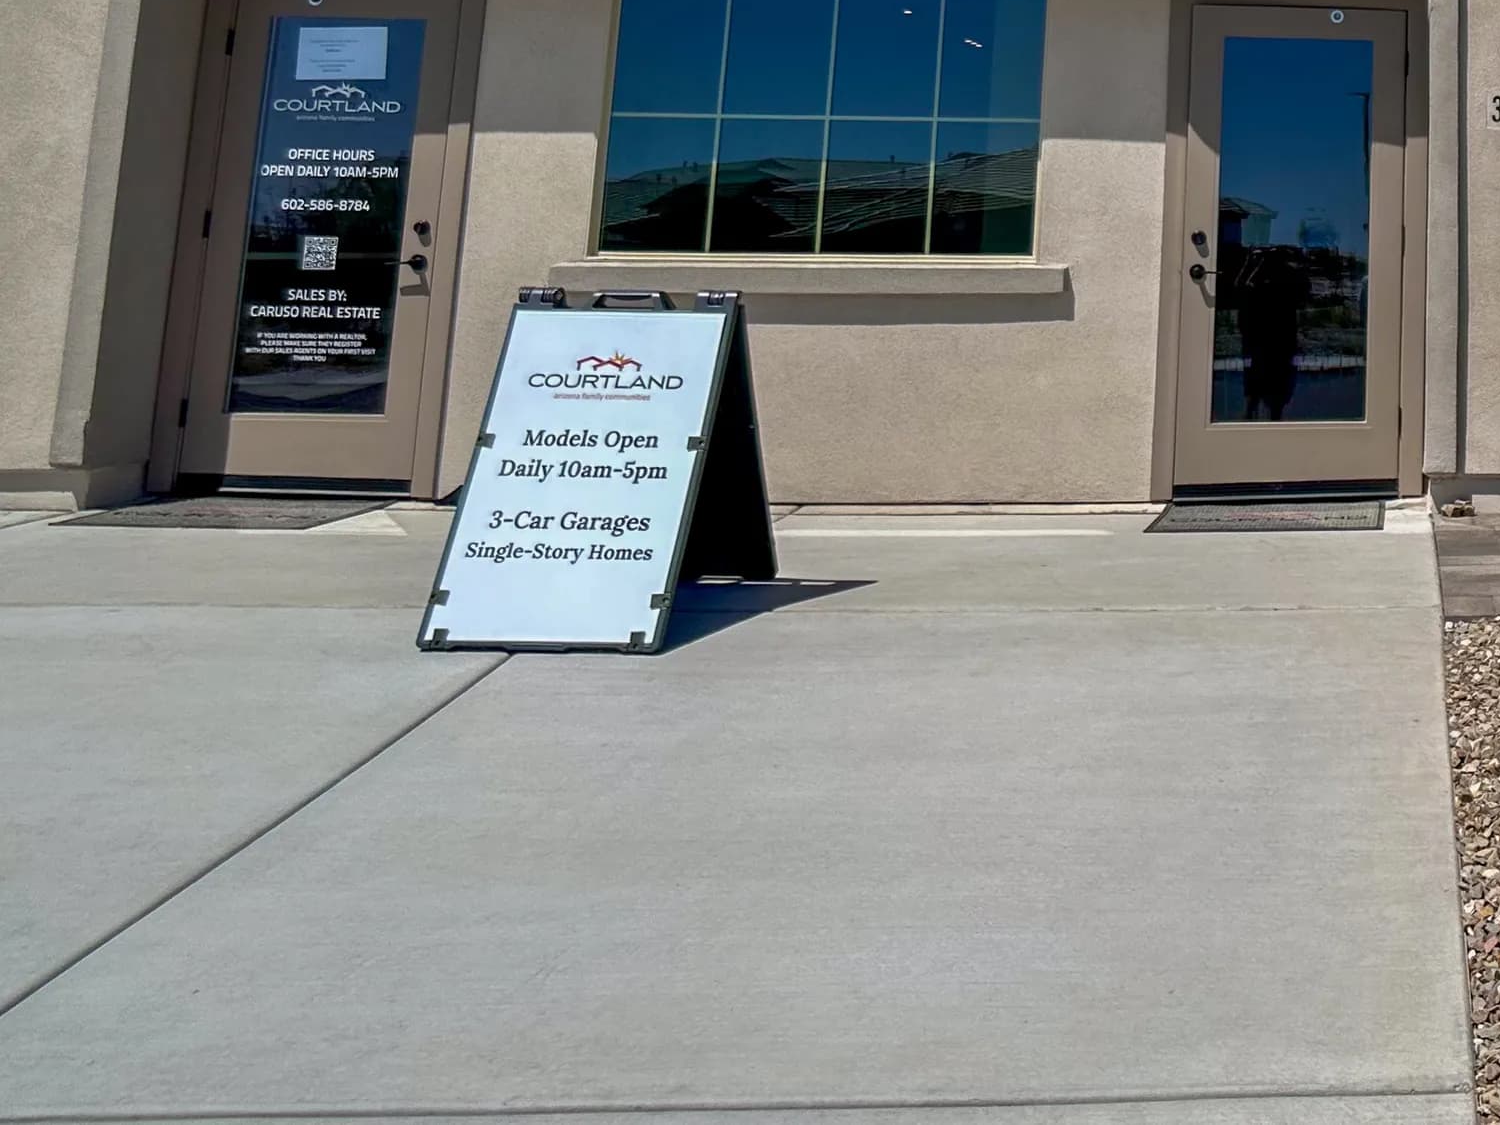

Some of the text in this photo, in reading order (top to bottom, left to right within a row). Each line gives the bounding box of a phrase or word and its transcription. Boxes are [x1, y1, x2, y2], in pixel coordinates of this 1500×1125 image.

[273, 99, 401, 113] COURTLAND
[288, 148, 375, 162] OFFICE HOURS
[261, 164, 399, 179] OPEN DAILY 10AM-5PM
[281, 199, 370, 212] 602-586-8784
[287, 288, 347, 302] SALES BY:
[250, 305, 381, 319] CARUSO REAL ESTATE
[314, 355, 327, 363] YOU
[343, 348, 361, 356] FIRST
[528, 373, 684, 390] COURTLAND
[581, 393, 604, 401] family
[604, 393, 651, 401] communities
[522, 429, 659, 453] Models Open
[498, 459, 668, 484] Daily 10am-5pm
[488, 510, 651, 537] 3-Car Garages
[464, 542, 653, 565] Single-Story Homes
